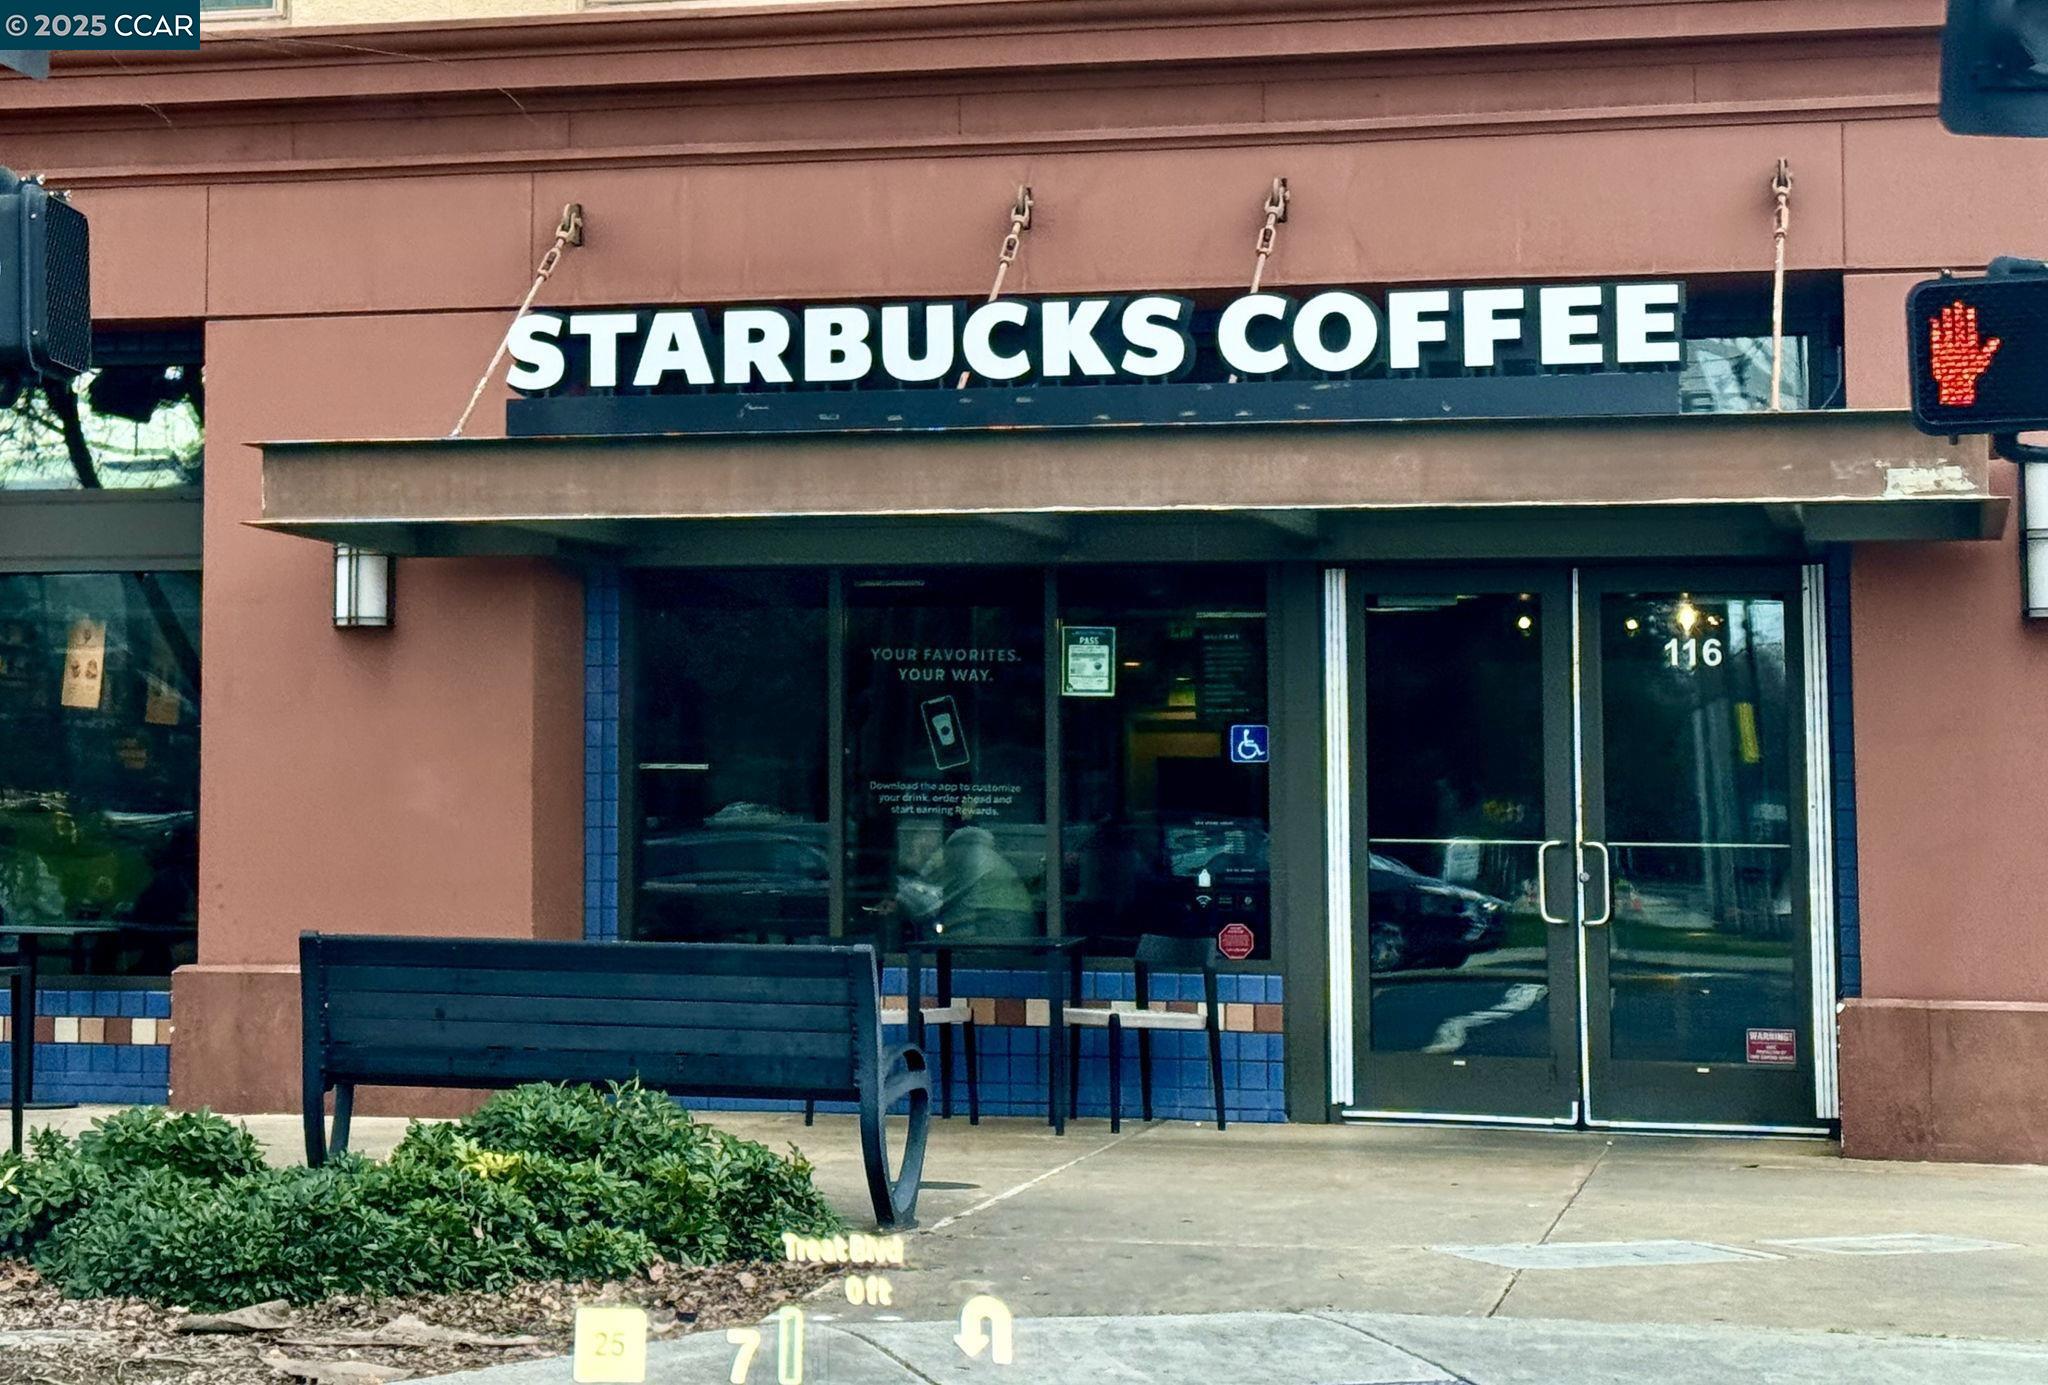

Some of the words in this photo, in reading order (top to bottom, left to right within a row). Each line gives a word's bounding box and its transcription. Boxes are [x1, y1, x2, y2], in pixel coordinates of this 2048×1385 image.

[505, 297, 1186, 391] STARBUCKS
[1217, 283, 1681, 375] COFFEE
[1079, 636, 1100, 645] PASS
[871, 648, 917, 661] YOUR
[923, 648, 1022, 662] FAVORITES.
[1664, 637, 1723, 667] 116
[899, 668, 945, 681] YOUR
[951, 669, 994, 682] WAY.
[869, 781, 918, 791] Download
[920, 782, 937, 791] the
[938, 784, 958, 793] app
[959, 783, 971, 792] to
[972, 783, 1022, 793] customize
[879, 795, 900, 804] your
[932, 794, 959, 803] order
[993, 796, 1013, 804] and
[891, 805, 914, 814] start
[916, 806, 954, 817] earning
[781, 1232, 849, 1262] Treat
[849, 1233, 904, 1263] Blvd
[594, 1331, 625, 1357] 25
